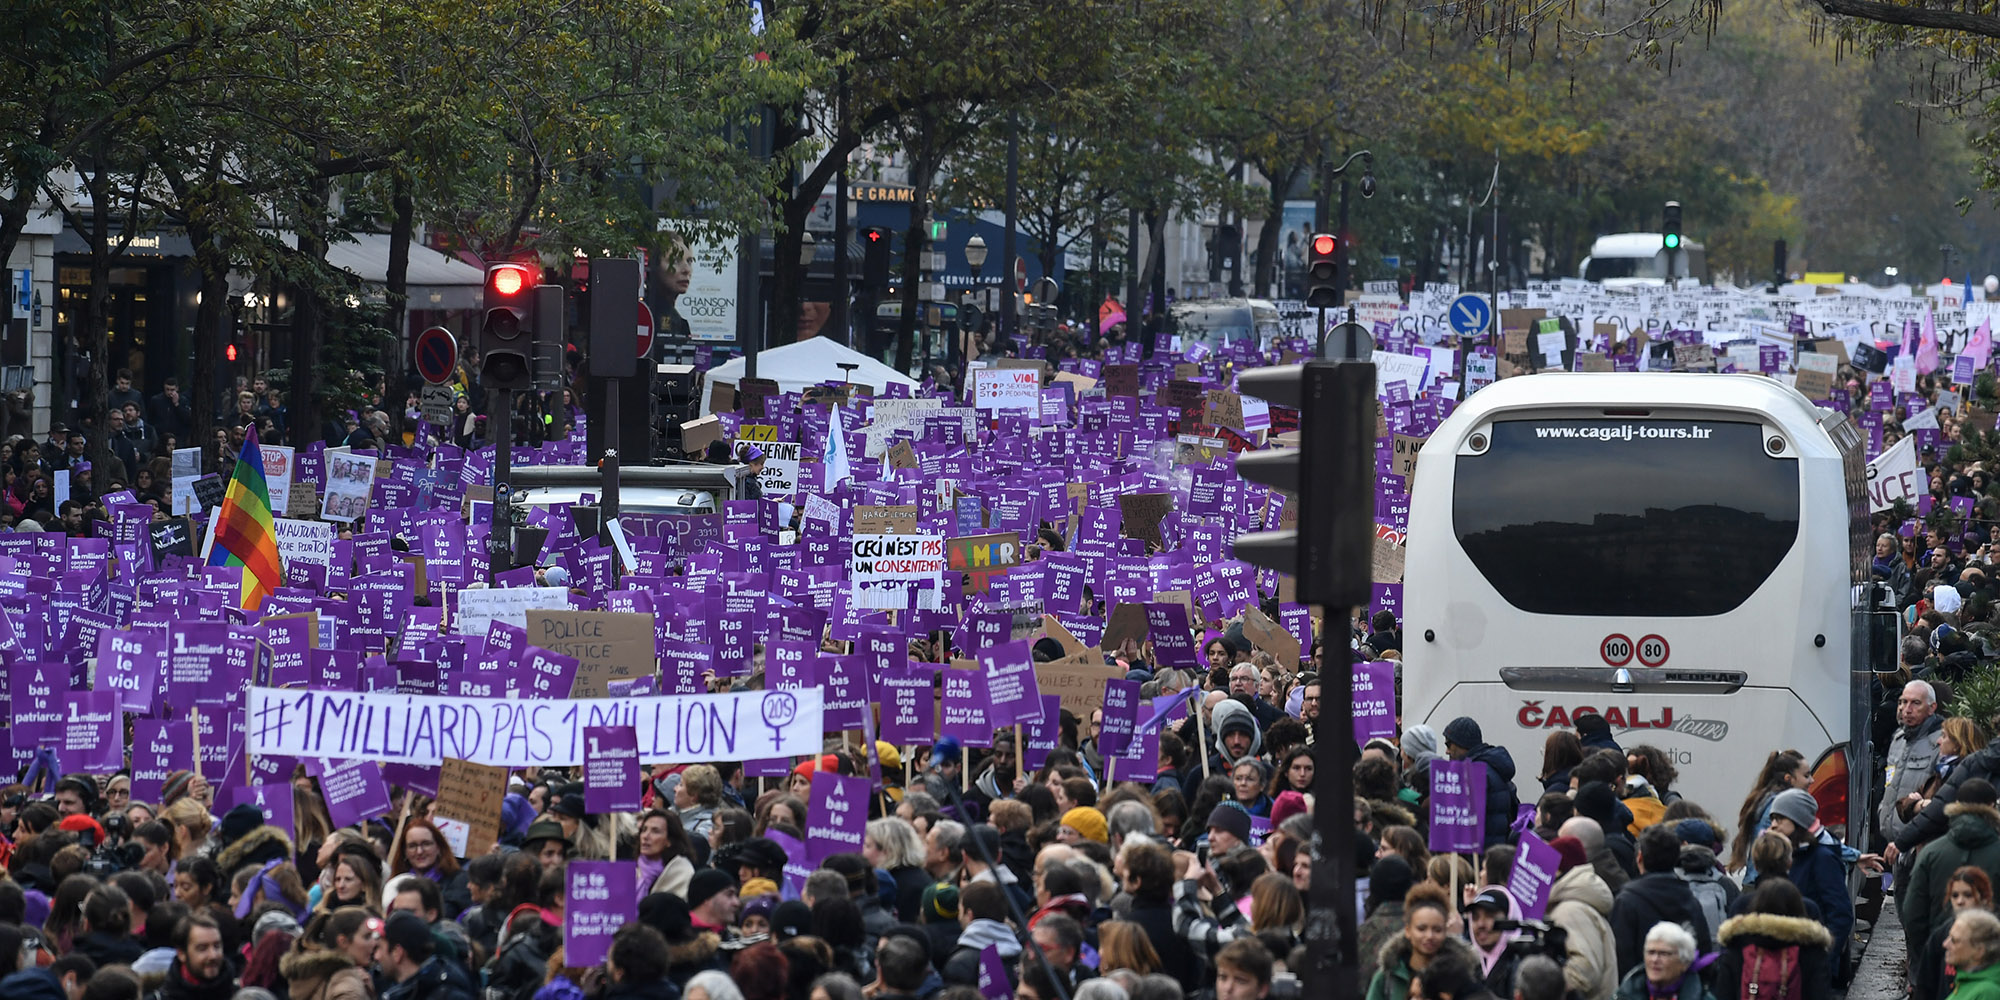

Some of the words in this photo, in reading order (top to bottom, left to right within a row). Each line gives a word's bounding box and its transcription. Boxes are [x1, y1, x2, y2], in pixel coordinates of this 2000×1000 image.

[847, 186, 864, 200] LE
[682, 297, 734, 307] CHANSON
[691, 307, 725, 317] DOUCE
[1013, 373, 1038, 383] VIOL
[721, 416, 734, 425] Ras
[1535, 425, 1712, 441] www.cagalj-tours.hr
[735, 441, 798, 461] CHERINE
[301, 458, 317, 466] Ras
[302, 475, 319, 484] viol
[1224, 493, 1232, 502] le
[1391, 506, 1408, 514] Ras
[371, 514, 385, 524] Ras
[1093, 521, 1108, 530] bas
[1096, 530, 1104, 540] le
[1193, 531, 1212, 541] Ras
[37, 538, 55, 547] Ras
[355, 538, 388, 547] Féminicides
[434, 538, 450, 548] bas
[745, 542, 761, 552] Ras
[809, 542, 829, 552] Ras
[885, 536, 919, 556] N'EST
[922, 539, 941, 555] PAS
[1197, 542, 1207, 552] le
[439, 548, 448, 556] le
[426, 557, 461, 566] patriarcat
[471, 559, 490, 570] Ras
[814, 554, 824, 564] le
[1192, 554, 1212, 564] viol
[855, 561, 873, 574] UN
[875, 560, 942, 574] CONSENTEMENT
[1047, 562, 1084, 574] Féminicides
[1220, 565, 1243, 577] Ras
[781, 574, 799, 587] Ras
[1009, 572, 1044, 580] Féminicides
[1056, 572, 1071, 580] pas
[370, 582, 404, 591] Féminicides
[1020, 580, 1034, 588] pas
[1228, 578, 1240, 589] le
[727, 581, 737, 597] 1
[737, 589, 765, 598] milliard
[612, 598, 620, 608] Je
[623, 598, 633, 607] te
[358, 606, 372, 615] bas
[362, 616, 369, 624] le
[719, 619, 742, 631] Ras
[1061, 620, 1100, 631] Féminicides
[976, 620, 1001, 634] Ras
[269, 628, 278, 638] Je
[278, 628, 288, 637] te
[173, 633, 188, 654] 1
[189, 644, 223, 654] milliard
[725, 634, 737, 645] le
[980, 634, 993, 649] le
[111, 638, 143, 654] Ras
[871, 639, 894, 653] Ras
[1605, 643, 1628, 657] 100
[1644, 643, 1662, 657] 80
[720, 646, 744, 660] viol
[776, 648, 803, 661] Ras
[116, 655, 132, 671] le
[532, 655, 562, 676] Ras
[877, 656, 889, 668] le
[322, 669, 341, 680] bas
[676, 668, 696, 677] une
[782, 665, 796, 676] le
[108, 674, 140, 690] viol
[533, 673, 550, 691] le
[680, 676, 692, 685] de
[829, 675, 849, 686] bas
[1360, 672, 1370, 681] te
[1665, 672, 1740, 683] NEOPLAN
[460, 681, 491, 696] Ras
[675, 683, 696, 694] plus
[946, 678, 957, 689] Je
[958, 678, 970, 688] te
[28, 684, 50, 696] bas
[836, 687, 847, 697] le
[946, 687, 972, 698] crois
[1108, 686, 1116, 699] Je
[1117, 688, 1126, 698] te
[35, 698, 46, 708] le
[490, 703, 552, 764] PAS
[562, 703, 579, 762] 1
[1031, 726, 1041, 736] le
[151, 742, 173, 753] bas
[588, 737, 601, 758] 1
[601, 747, 637, 758] milliard
[156, 755, 168, 766] le
[1435, 770, 1445, 783] Je
[1446, 770, 1459, 783] te
[833, 780, 845, 797] À
[1435, 783, 1462, 794] crois
[825, 796, 850, 811] bas
[830, 811, 844, 826] le
[1517, 841, 1530, 869] 1
